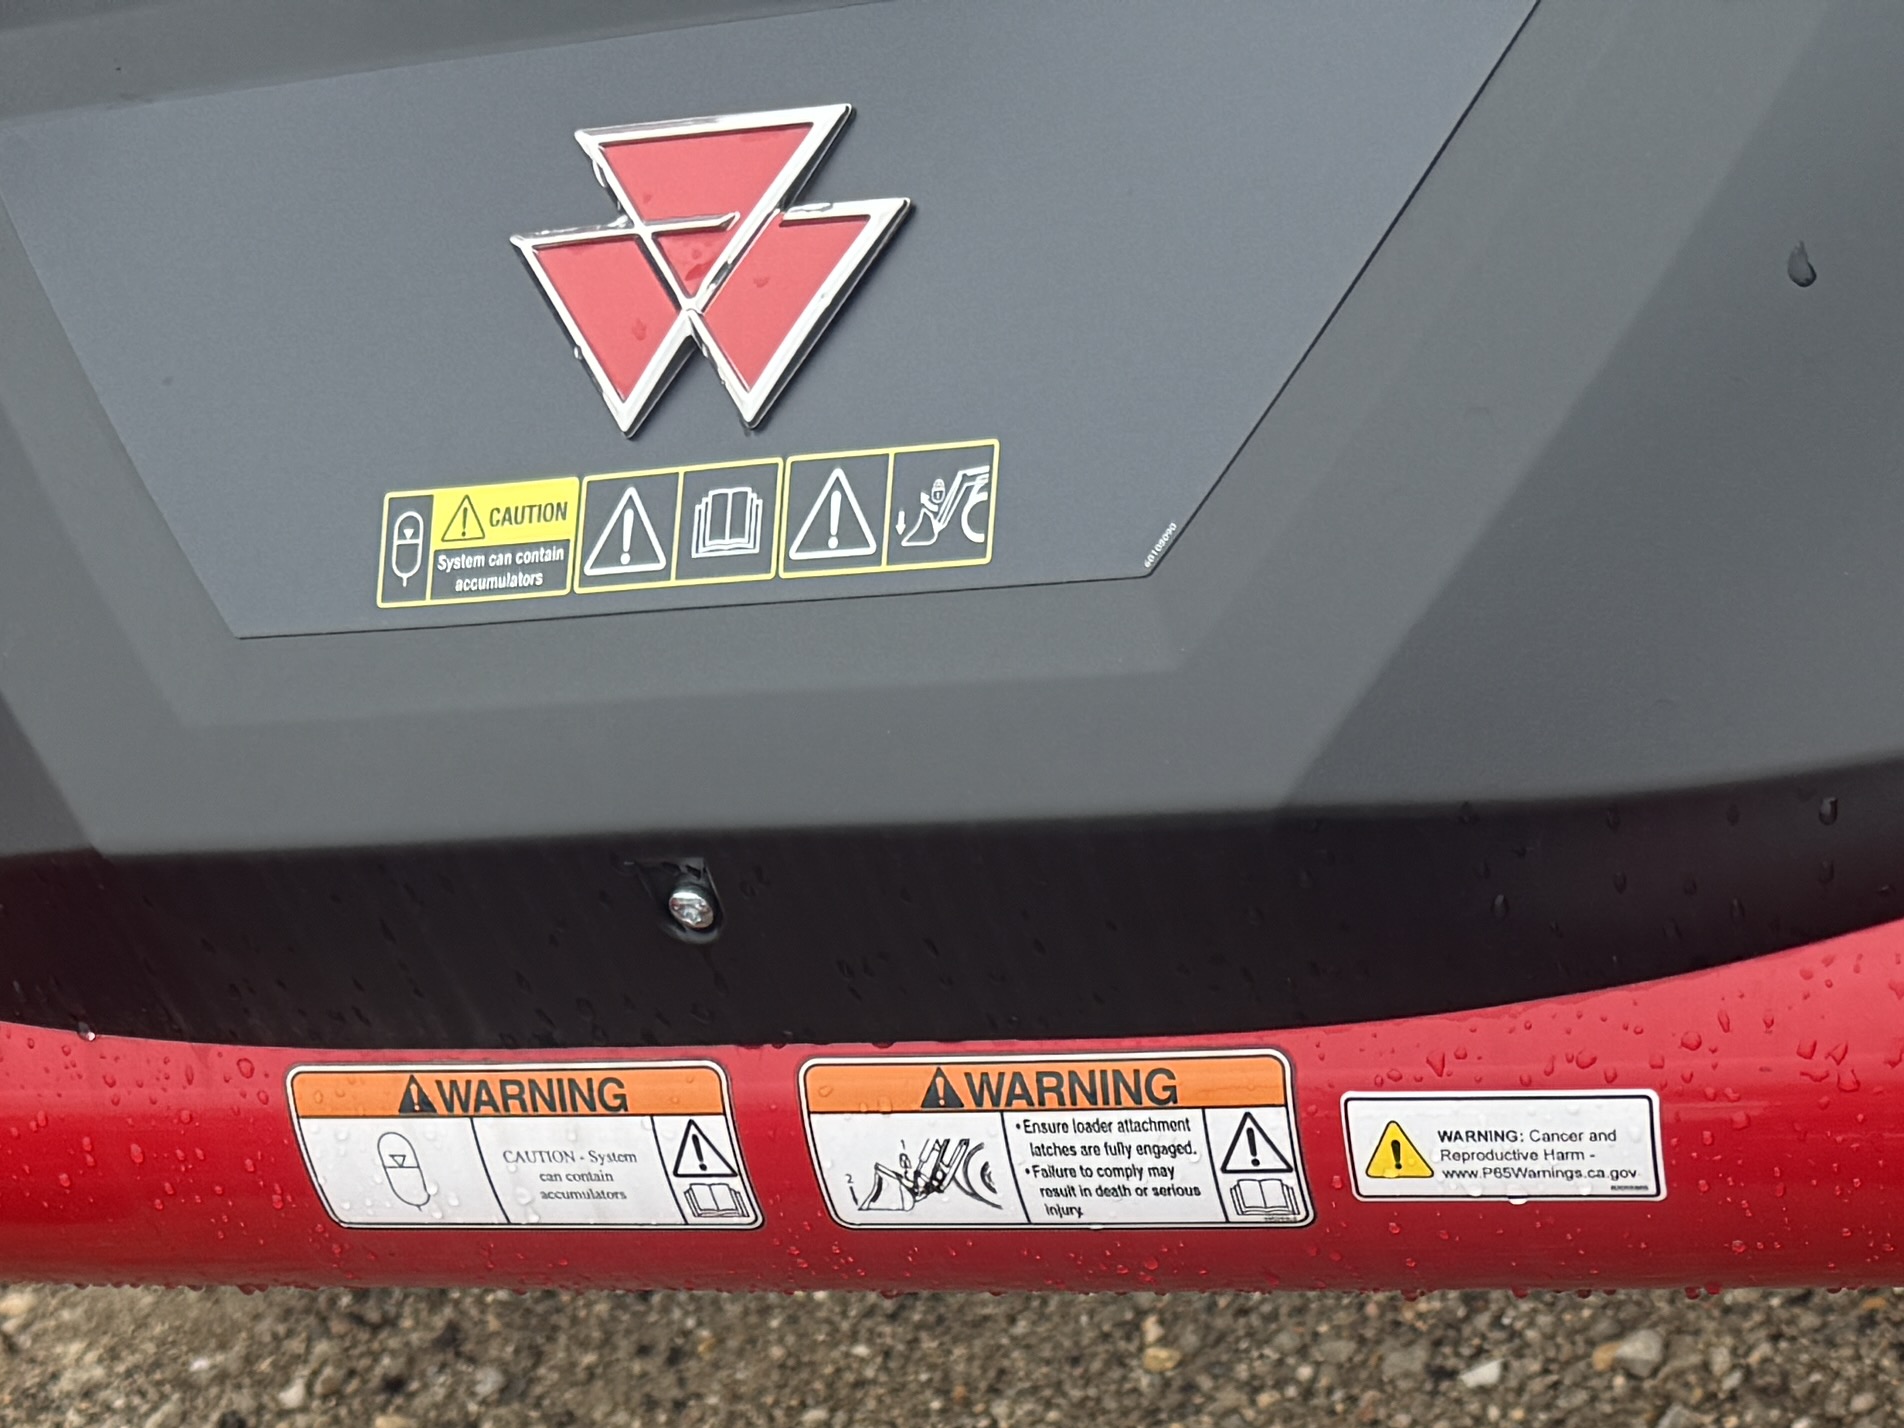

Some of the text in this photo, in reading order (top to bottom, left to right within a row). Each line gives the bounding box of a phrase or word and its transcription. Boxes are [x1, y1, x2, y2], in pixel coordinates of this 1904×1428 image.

[489, 501, 569, 528] CAUTION
[437, 545, 564, 573] System can contain
[455, 571, 544, 592] accumulators
[435, 1076, 629, 1113] WARNING
[964, 1067, 1179, 1108] WARNING
[1022, 1117, 1192, 1134] Ensure loader attachment
[1437, 1129, 1617, 1143] WARNING: Cancer and
[503, 1150, 576, 1164] CAUTION
[588, 1150, 637, 1166] System
[1029, 1140, 1198, 1160] latches are fully engaged.
[1440, 1149, 1539, 1164] Reproductive
[1543, 1149, 1585, 1161] Harm
[539, 1170, 614, 1182] can contain
[1031, 1164, 1175, 1181] Failure to comply may
[1442, 1166, 1637, 1181] www.P65Warnings.ca.gov
[540, 1188, 627, 1200] accumulators
[1039, 1184, 1201, 1197] result in death or serious
